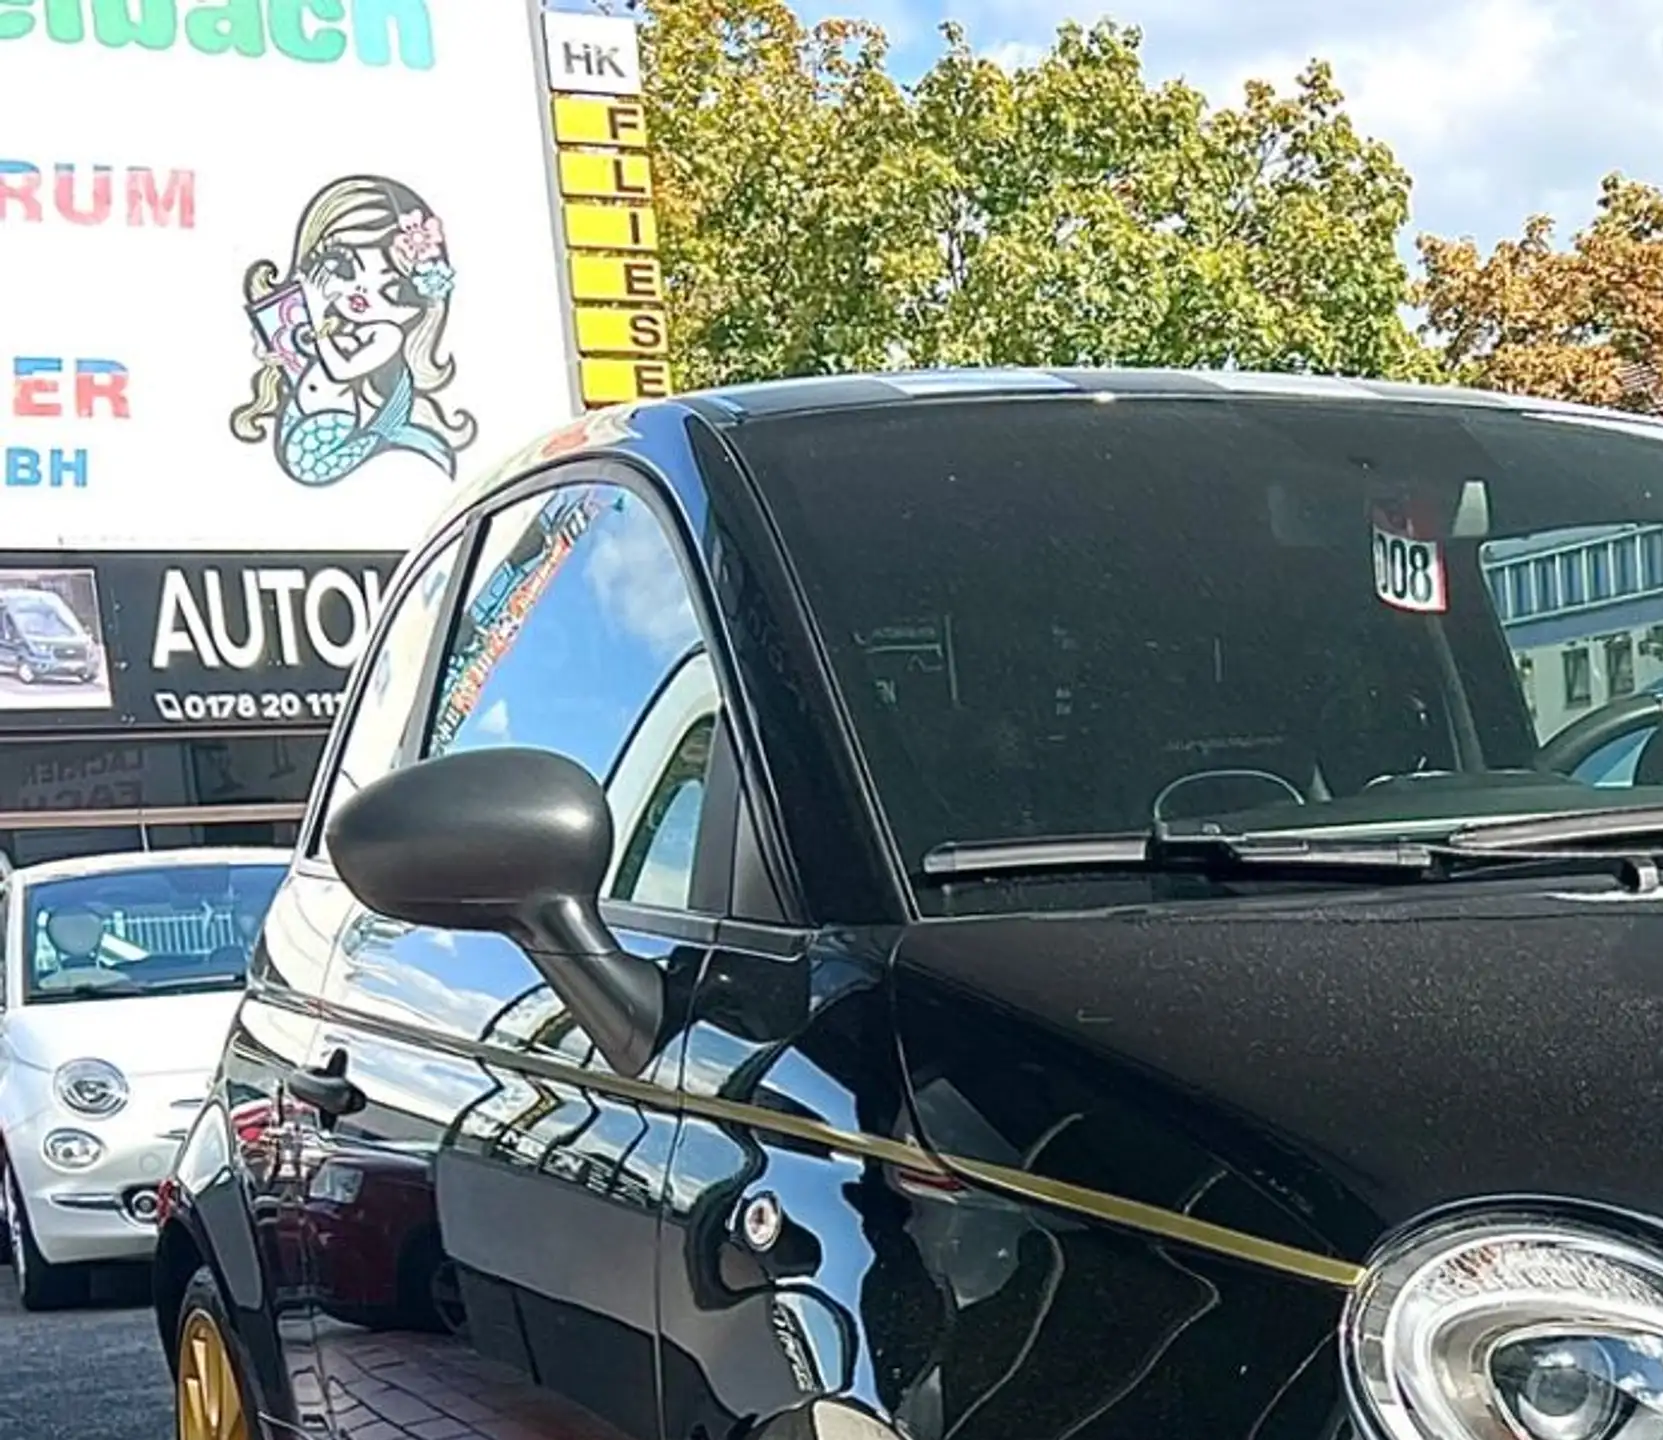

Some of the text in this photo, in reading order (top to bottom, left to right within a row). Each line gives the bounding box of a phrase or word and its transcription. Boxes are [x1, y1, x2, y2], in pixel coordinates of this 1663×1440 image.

[13, 357, 130, 418] ER
[6, 448, 88, 487] BH
[261, 693, 301, 718] 20
